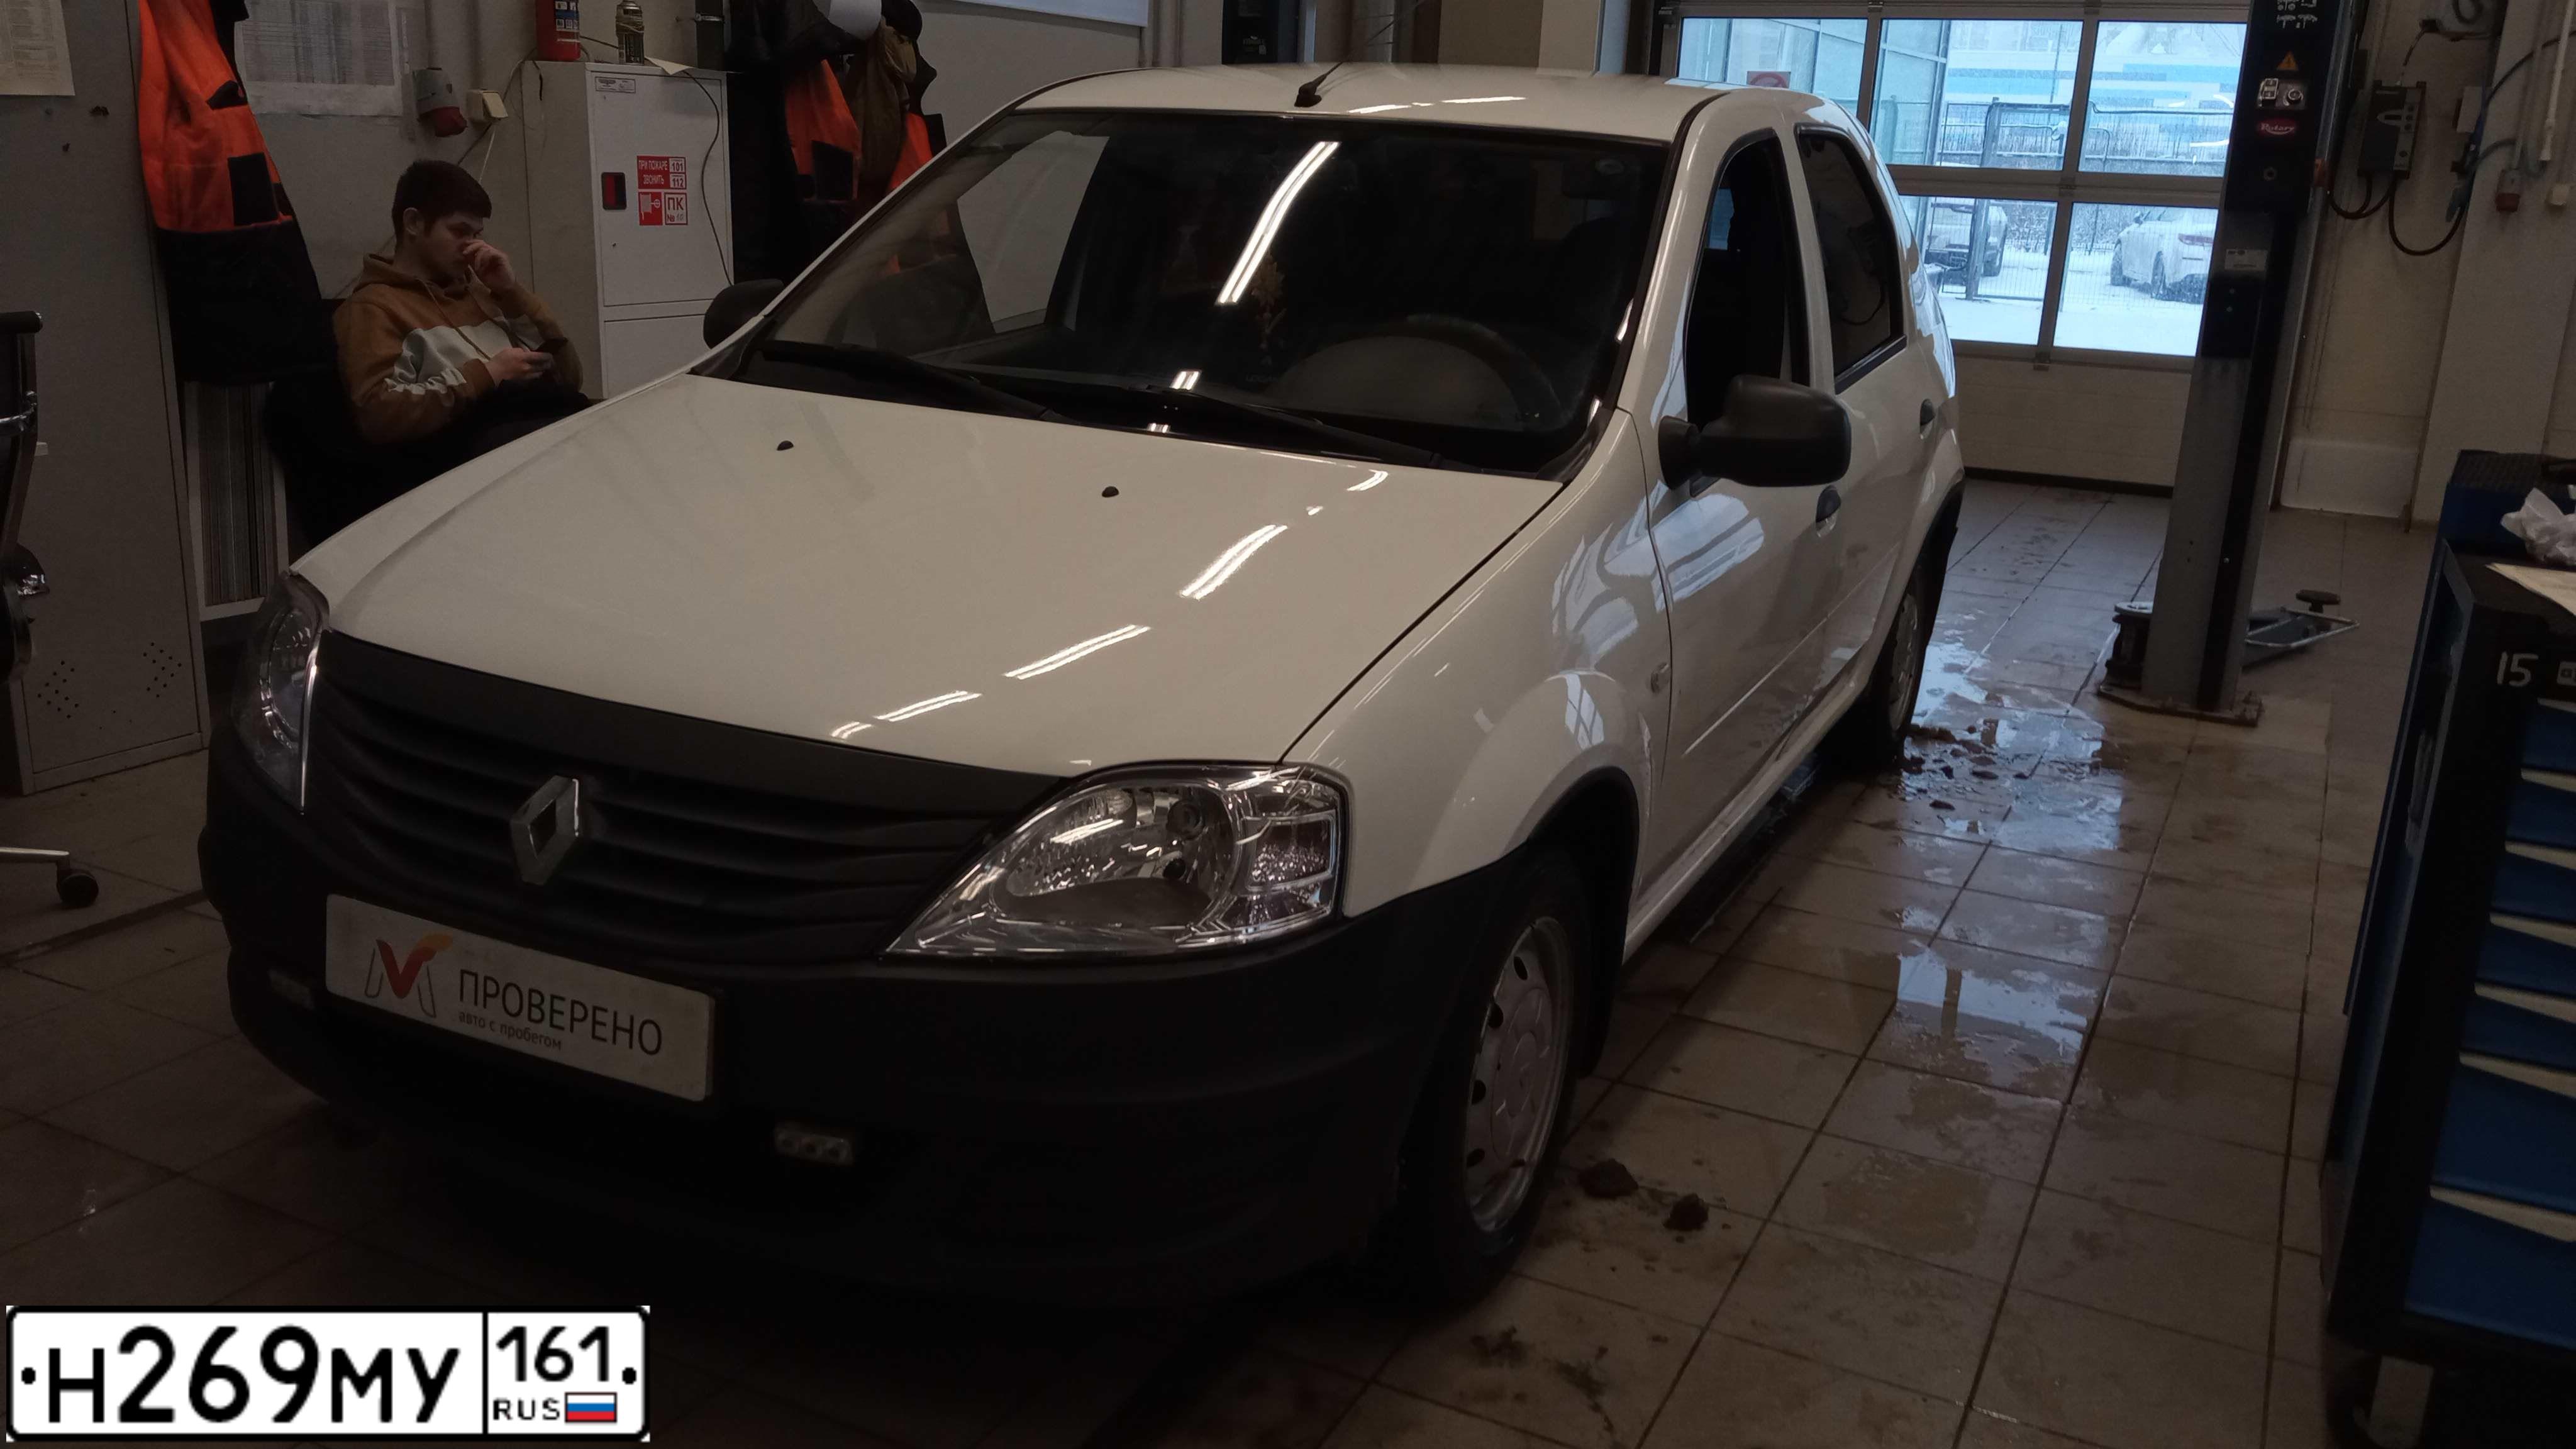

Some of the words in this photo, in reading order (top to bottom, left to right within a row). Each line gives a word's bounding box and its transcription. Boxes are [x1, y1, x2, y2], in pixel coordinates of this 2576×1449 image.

[2260, 123, 2295, 135] Rotary
[638, 160, 648, 170] ПРИ
[648, 160, 668, 171] ПОЖАРЕ
[672, 162, 684, 172] 101
[643, 174, 664, 185] ЗВОНИТЬ
[672, 177, 684, 187] 112
[667, 197, 684, 211] ПК
[2497, 652, 2538, 686] 15
[460, 969, 662, 1055] ПРОВЕРЕНО
[458, 1011, 486, 1029] авто
[489, 1021, 495, 1031] с
[500, 1024, 562, 1051] пробегом
